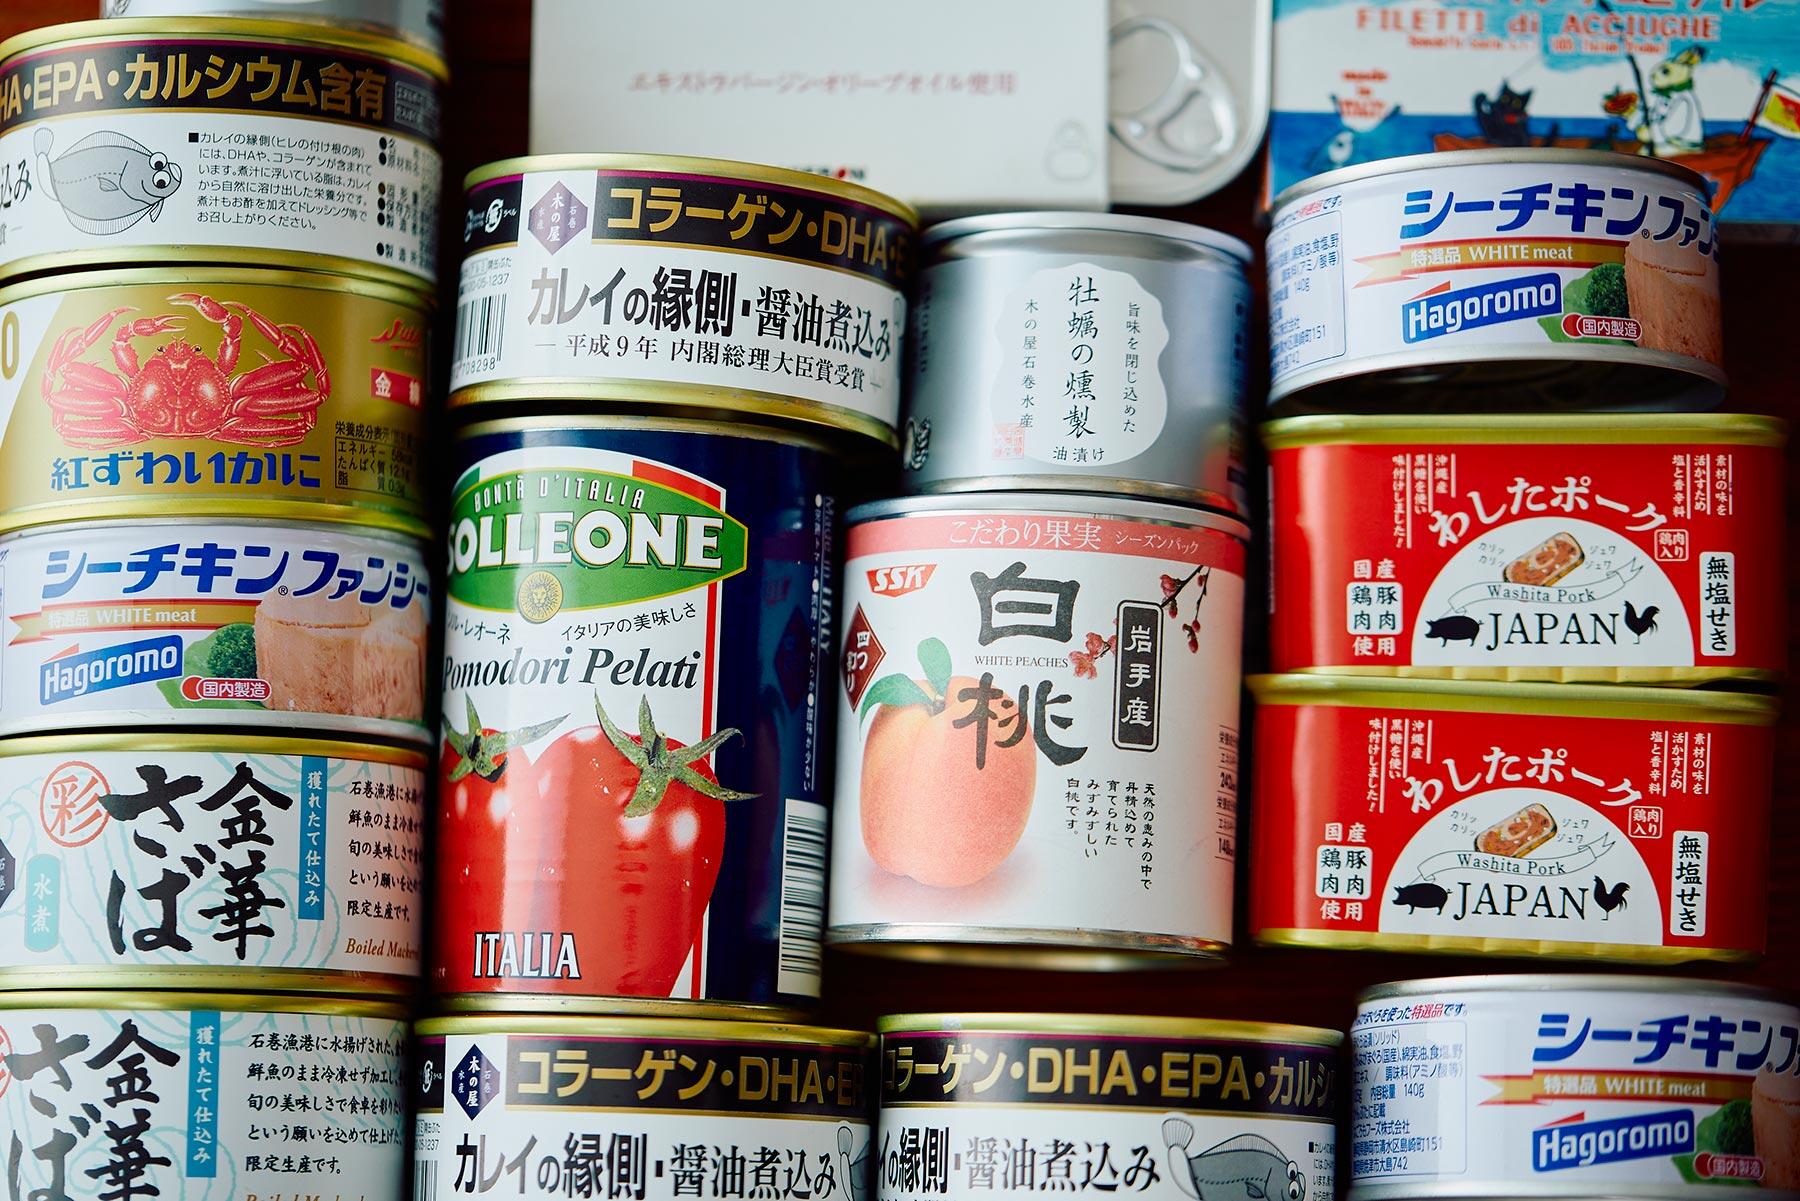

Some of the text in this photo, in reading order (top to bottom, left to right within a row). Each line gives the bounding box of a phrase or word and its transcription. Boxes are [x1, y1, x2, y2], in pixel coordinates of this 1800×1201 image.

[1356, 9, 1721, 40] FILETTI di ACCIUGHE
[197, 211, 317, 231] お召し上がりください。
[547, 192, 565, 242] 木の屋
[1410, 245, 1573, 265] 特選品 WHITE meat
[1408, 283, 1557, 340] Hagoromo
[1582, 319, 1638, 338] 国内製造
[1019, 299, 1039, 429] 木の屋石巻水産
[1062, 276, 1101, 439] 牡蠣の燻製
[1122, 302, 1141, 433] 旨味を閉じ込めた
[1053, 446, 1105, 463] 油漬け
[1693, 455, 1706, 511] 活かすため
[1715, 455, 1727, 516] 素材の味を
[949, 518, 1200, 555] こだわり果実 シーズンパック
[1429, 475, 1667, 548] わしたポーク
[873, 565, 926, 591] SSK
[1353, 559, 1396, 579] 国産
[1487, 585, 1596, 602] Washita Pork
[96, 608, 153, 624] WHITE
[155, 608, 197, 622] meat
[561, 602, 697, 642] イタリアの美味しさ
[1705, 556, 1732, 652] 無塩せき
[1352, 637, 1396, 656] 使用
[1486, 612, 1620, 651] JAPAN
[43, 645, 179, 702] Hagoromo
[443, 646, 702, 692] Pomodori Pelati
[974, 655, 1069, 669] WHITE PEACHES
[1122, 625, 1153, 727] 岩手産
[203, 682, 266, 698] 国内製造
[1402, 746, 1643, 815] わしたポーク
[1648, 731, 1663, 794] 塩と香辛料
[1670, 732, 1684, 789] 活かすため
[1692, 733, 1705, 794] 素材の味を
[51, 775, 103, 839] 彩
[1065, 777, 1081, 835] 白桃です。
[1085, 779, 1101, 857] みずみずしい
[1105, 780, 1120, 846] 育てられた
[1124, 781, 1139, 848] 丹精込めて
[303, 770, 323, 906] 獲れたて仕込み
[1140, 783, 1156, 890] 天然の恵みの中で
[1324, 822, 1366, 843] 国産
[100, 764, 216, 955] さば
[200, 761, 294, 960] 金華
[1457, 853, 1567, 875] Washita Pork
[1675, 835, 1703, 932] 無塩せき
[31, 873, 53, 934] 水煮
[1321, 901, 1363, 921] 使用
[1453, 881, 1590, 920] JAPAN
[345, 938, 386, 957] Boiled
[473, 931, 582, 979] ITALIA
[193, 1026, 215, 1164] 獲れたて仕込み
[466, 1055, 481, 1107] 木の屋
[1404, 1083, 1425, 1098] 140g
[1543, 1074, 1706, 1097] 特選品 WHITE meat
[245, 1155, 341, 1174] 限定生産です。
[1539, 1120, 1690, 1171] Hagoromo
[1712, 1158, 1761, 1177] 国内製造
